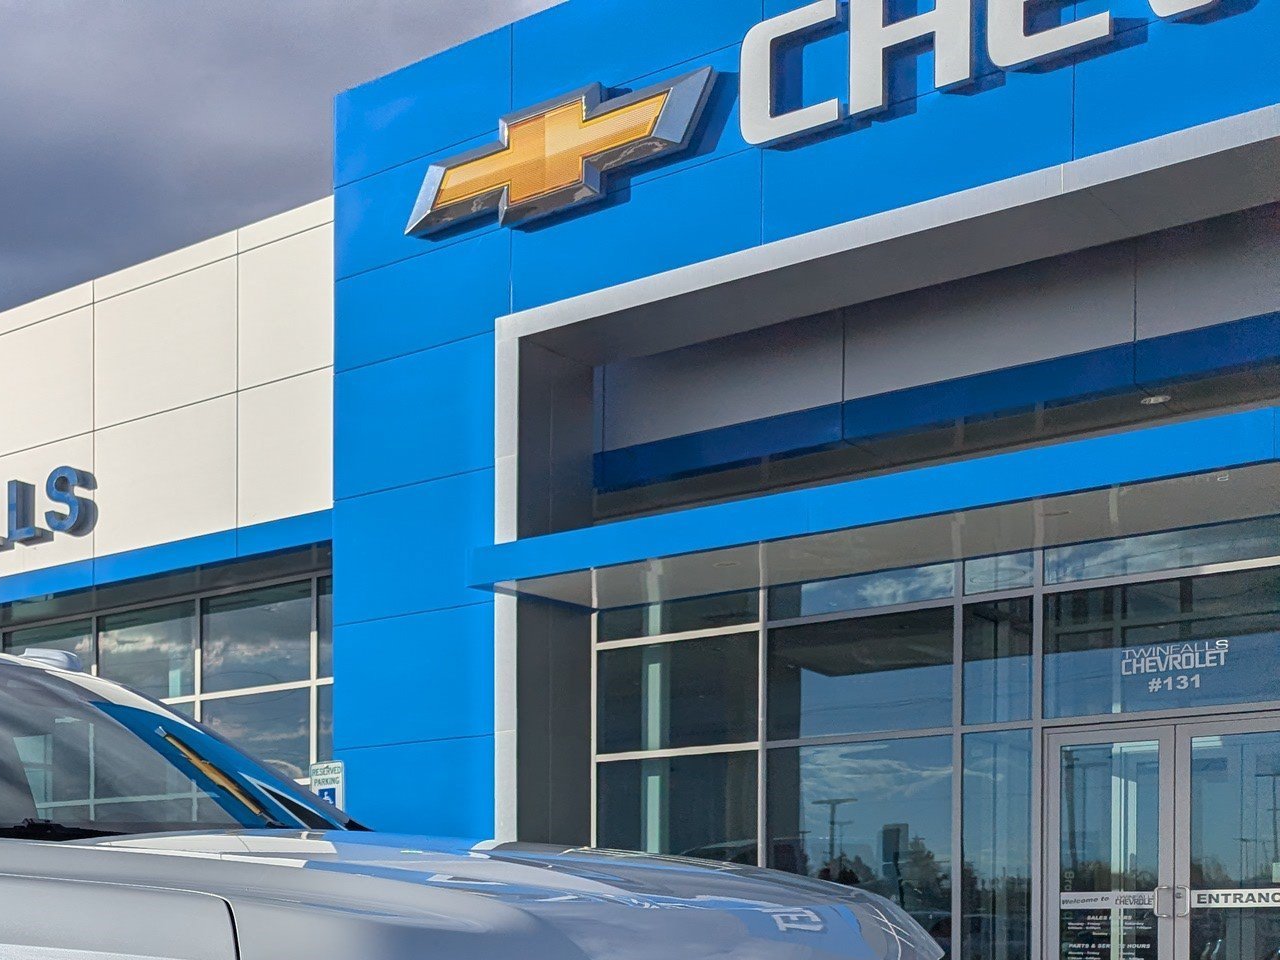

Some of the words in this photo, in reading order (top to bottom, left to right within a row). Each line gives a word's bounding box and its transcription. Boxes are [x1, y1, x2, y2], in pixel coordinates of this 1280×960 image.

[740, 0, 1224, 148] CH
[1121, 649, 1229, 676] CHEVROLET
[1148, 673, 1201, 693] #131
[312, 766, 341, 777] RESERVED
[313, 777, 340, 787] PARKING
[1061, 897, 1099, 906] Welcome
[1114, 897, 1154, 906] CHEVROLE
